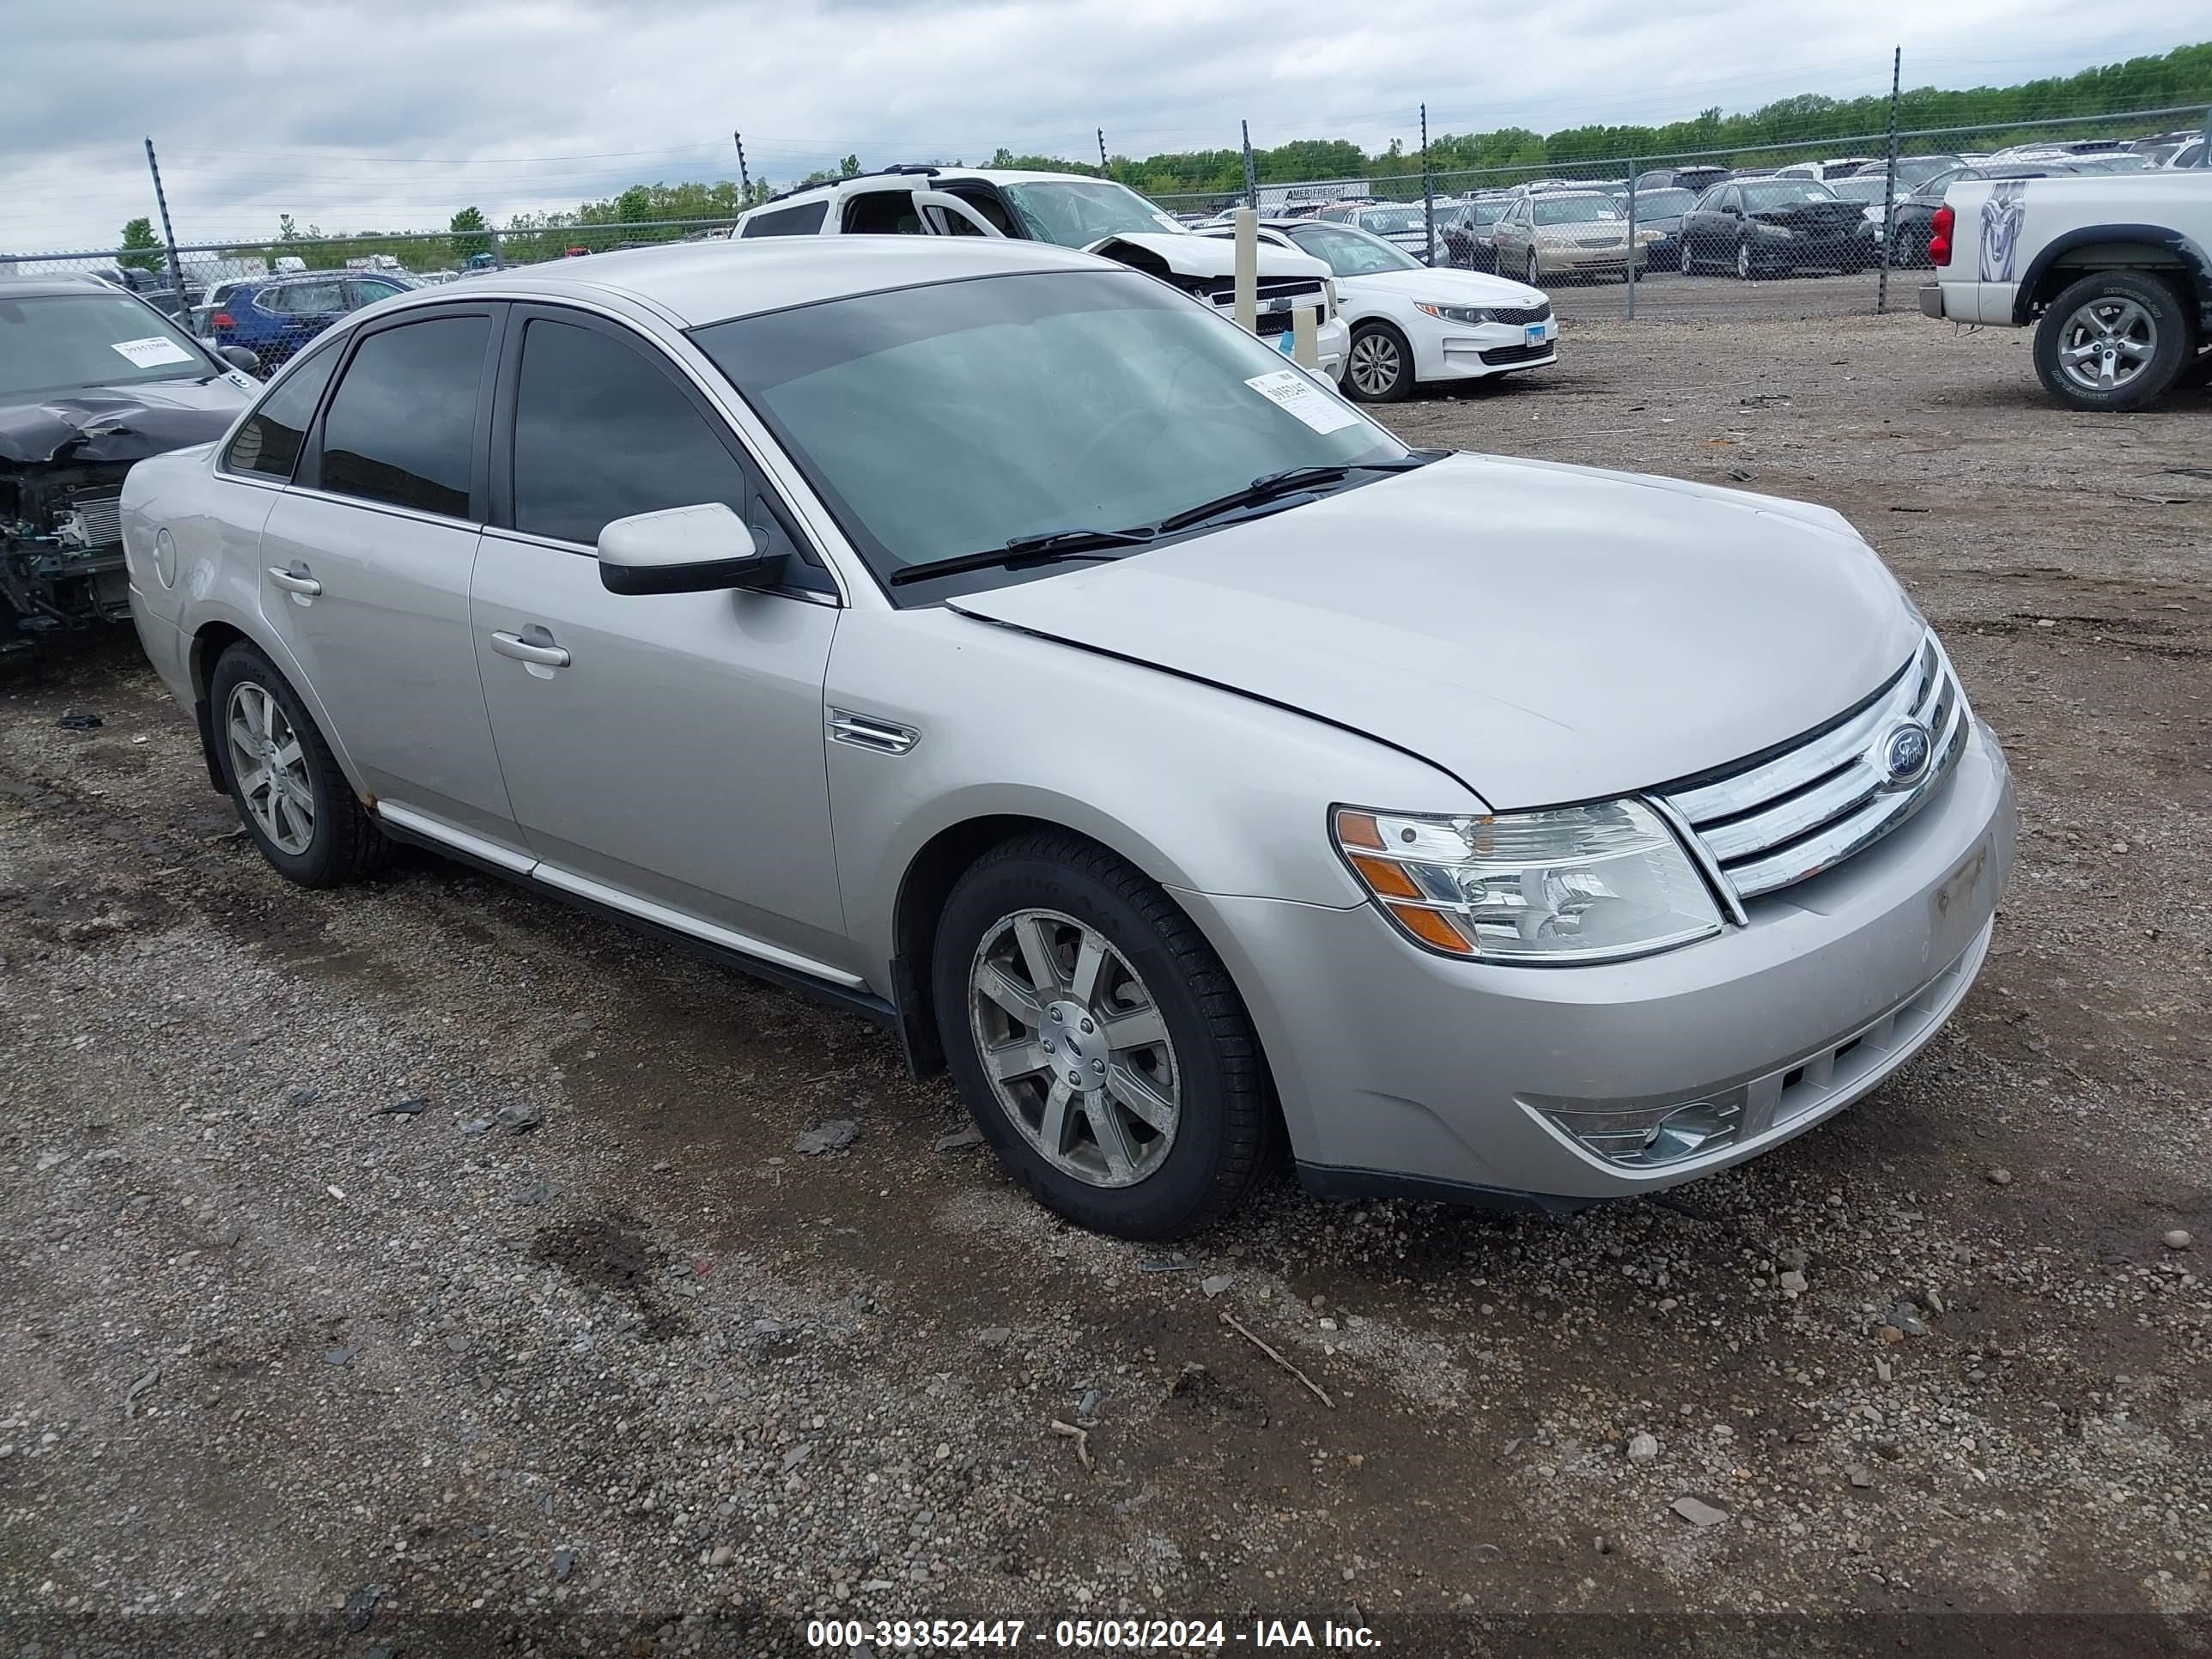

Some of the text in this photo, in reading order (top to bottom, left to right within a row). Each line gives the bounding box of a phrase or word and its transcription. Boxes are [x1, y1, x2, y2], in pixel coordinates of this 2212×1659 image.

[1285, 186, 1346, 200] AMERIFREIGHT
[2104, 287, 2162, 319] MICHELIN
[2051, 370, 2110, 401] MICHELIN
[1896, 736, 1924, 766] Ford
